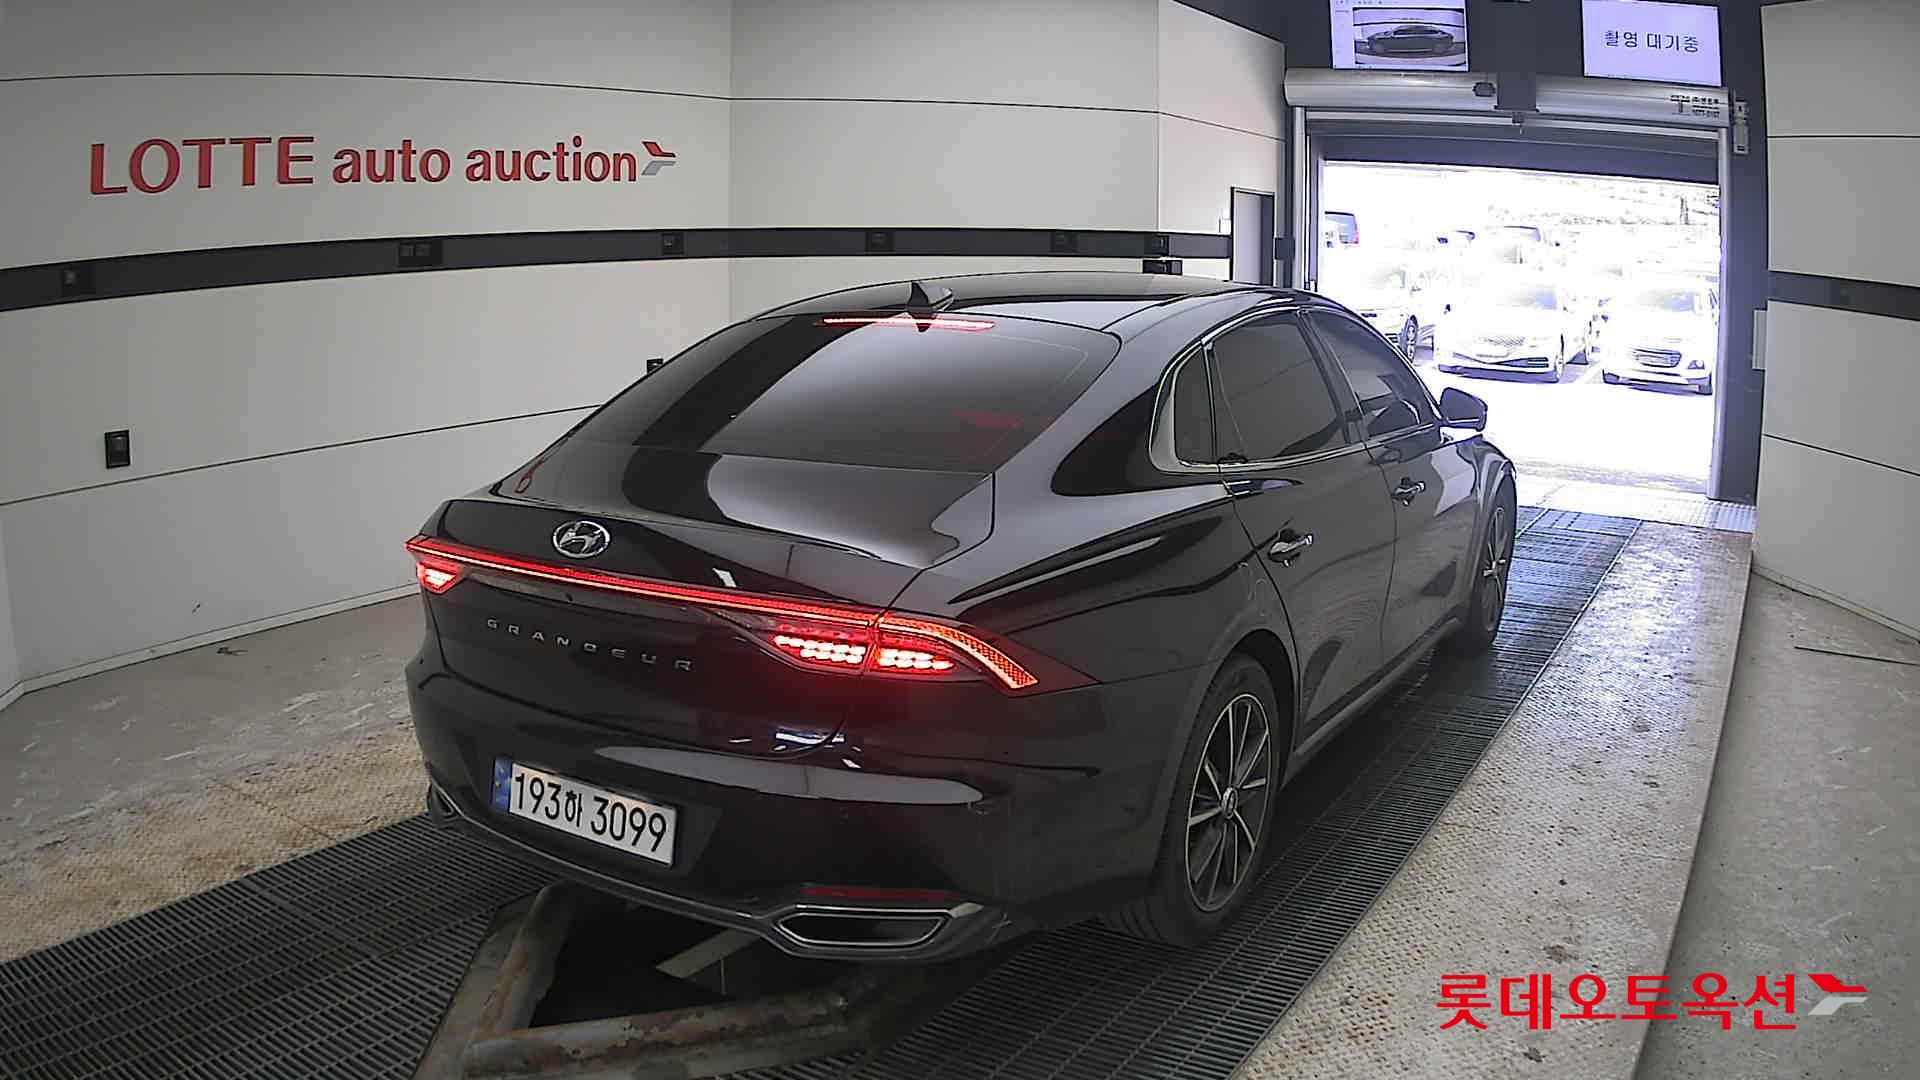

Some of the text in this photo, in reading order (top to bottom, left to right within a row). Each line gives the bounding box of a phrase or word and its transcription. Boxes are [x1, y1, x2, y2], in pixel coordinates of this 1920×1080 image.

[1604, 30, 1699, 53] 촬영 대기중
[90, 135, 638, 195] LOTTE auto auction
[486, 618, 693, 672] GRANDEUR
[514, 771, 668, 853] 193하 3099
